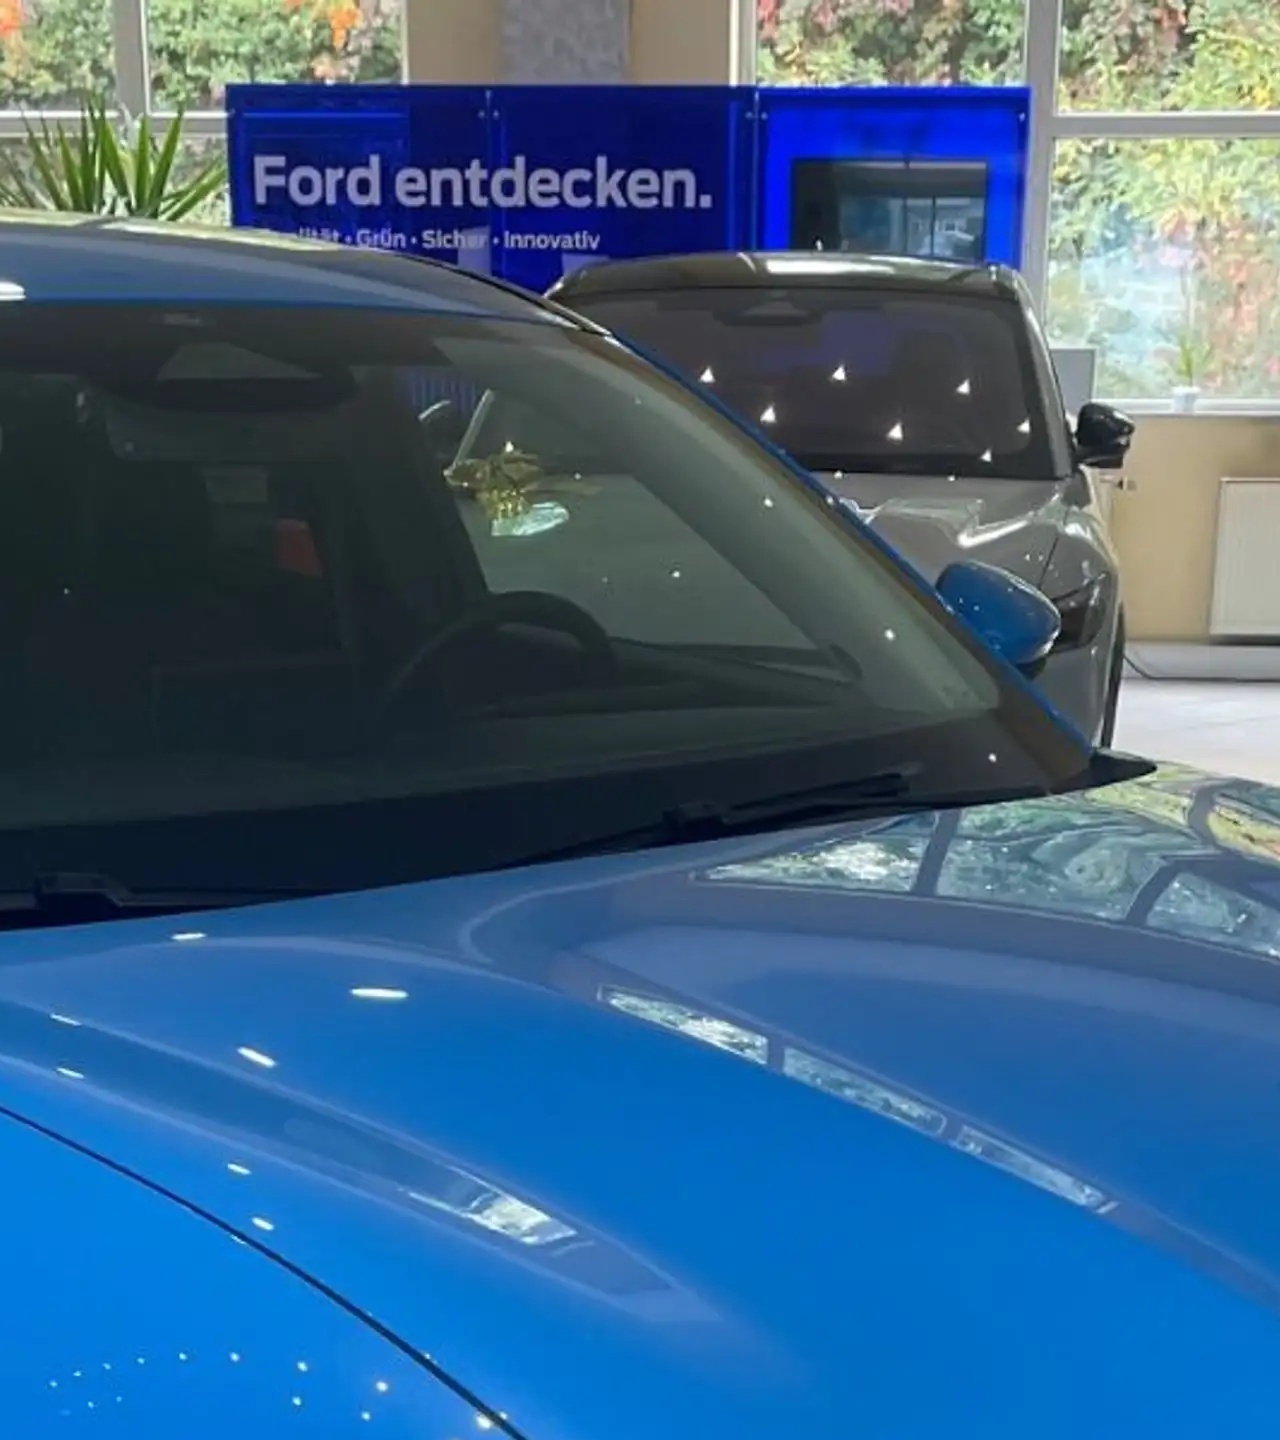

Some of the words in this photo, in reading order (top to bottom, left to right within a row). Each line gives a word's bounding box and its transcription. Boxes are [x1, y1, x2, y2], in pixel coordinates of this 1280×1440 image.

[253, 153, 381, 206] Ford
[395, 155, 713, 208] entdecken.
[356, 226, 407, 249] Grün
[421, 228, 489, 249] Sicher
[504, 229, 601, 250] Innovativ
